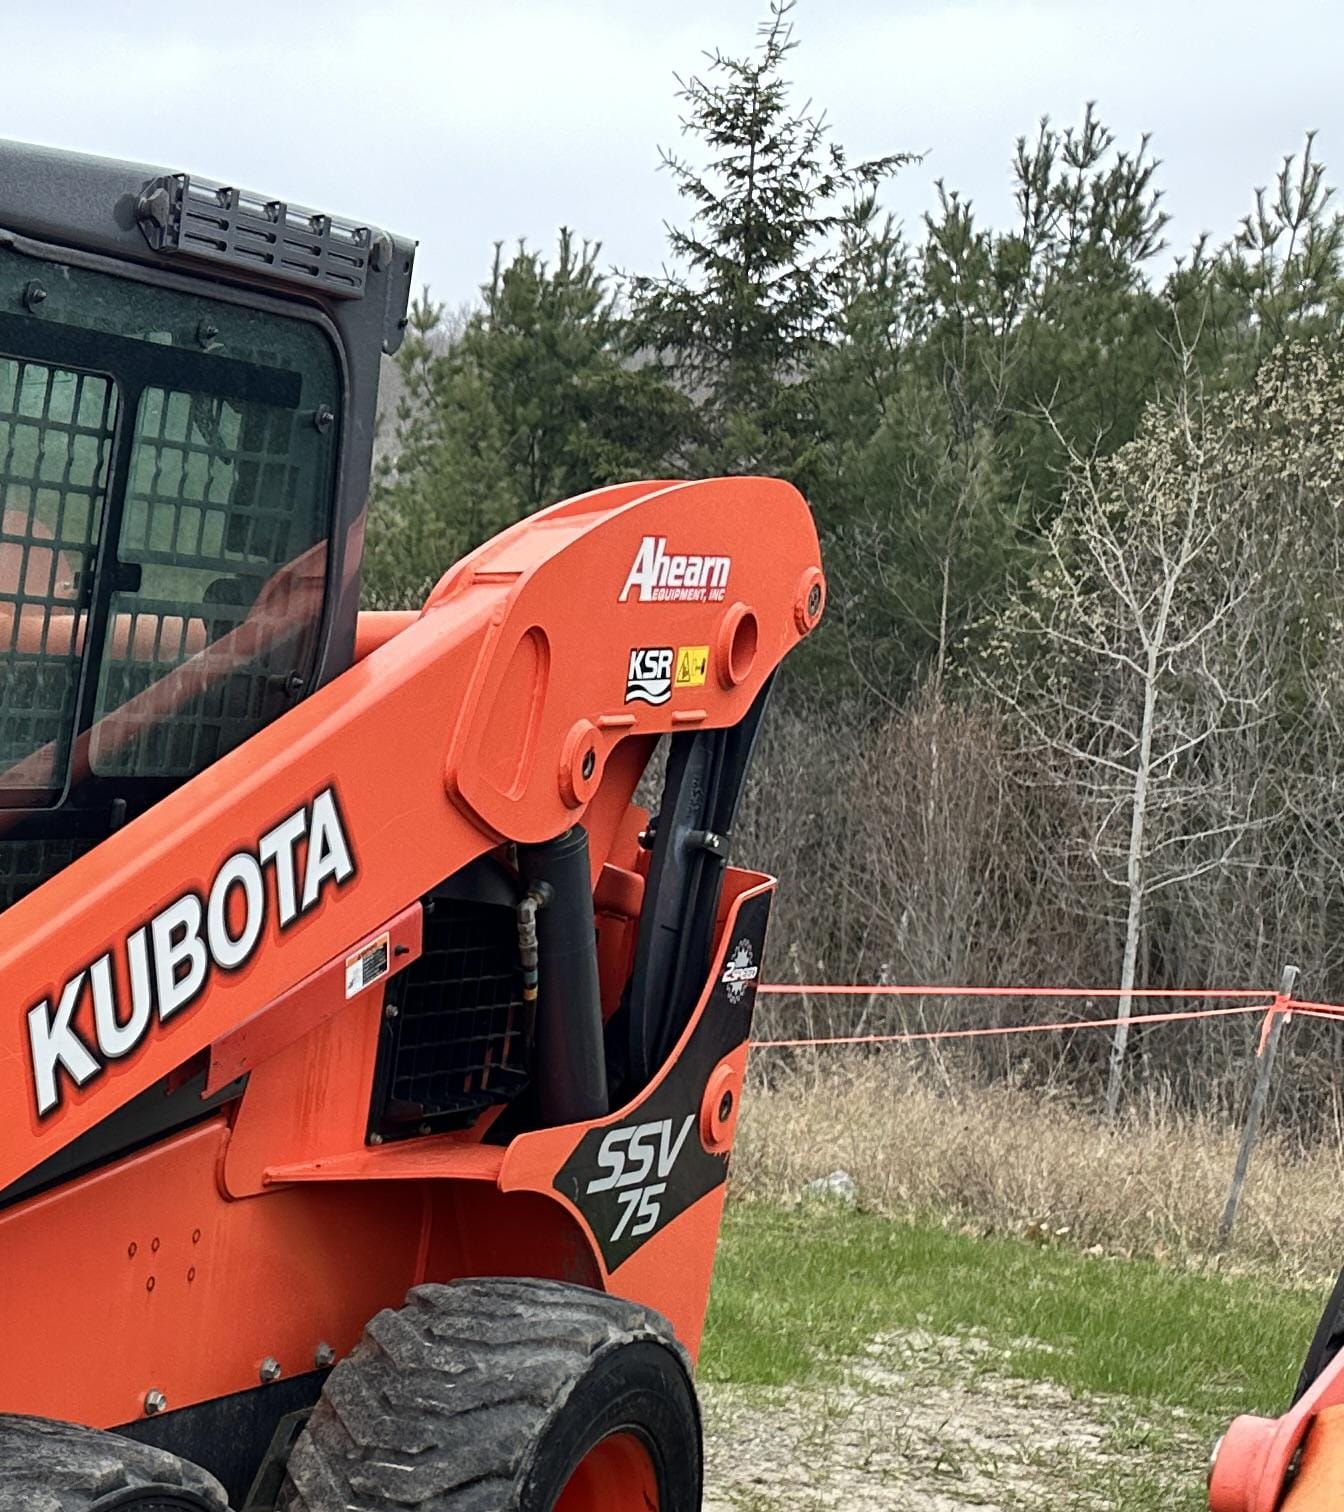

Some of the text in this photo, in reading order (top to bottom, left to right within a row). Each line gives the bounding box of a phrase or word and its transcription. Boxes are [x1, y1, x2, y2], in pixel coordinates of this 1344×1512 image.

[618, 536, 731, 602] Ahearn
[652, 587, 727, 604] EQUIPMENT, INC
[629, 649, 674, 681] KSR
[27, 787, 355, 1116] KUBOTA
[586, 1113, 696, 1195] SSV
[609, 1182, 667, 1242] 75
